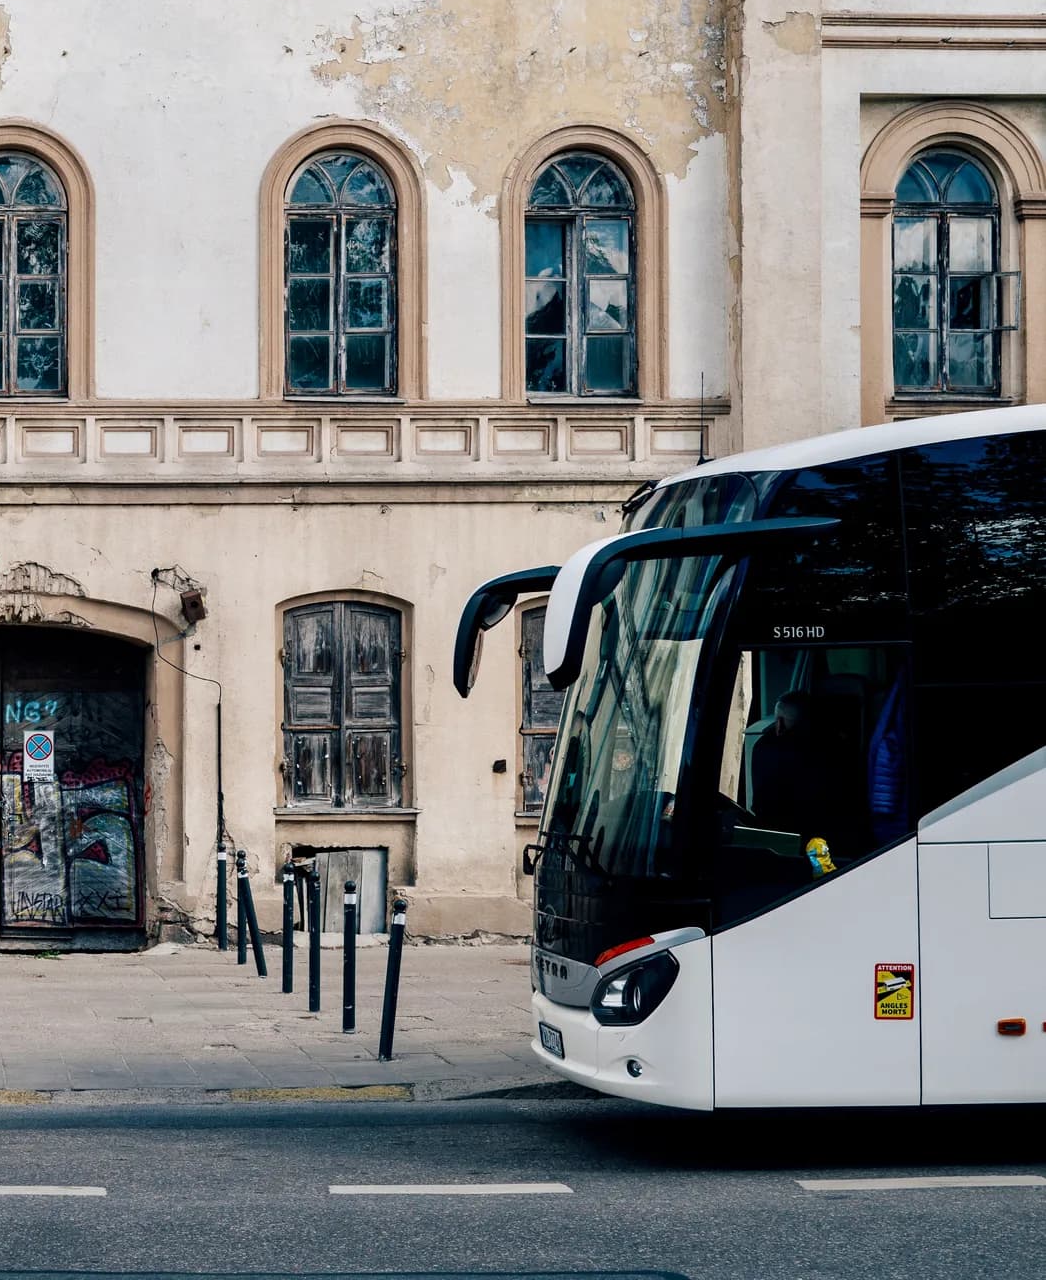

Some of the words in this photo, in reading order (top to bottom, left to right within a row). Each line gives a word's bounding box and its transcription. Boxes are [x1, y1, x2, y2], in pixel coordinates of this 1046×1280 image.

[773, 626, 781, 638] S
[783, 626, 804, 638] 516
[806, 626, 825, 638] HD
